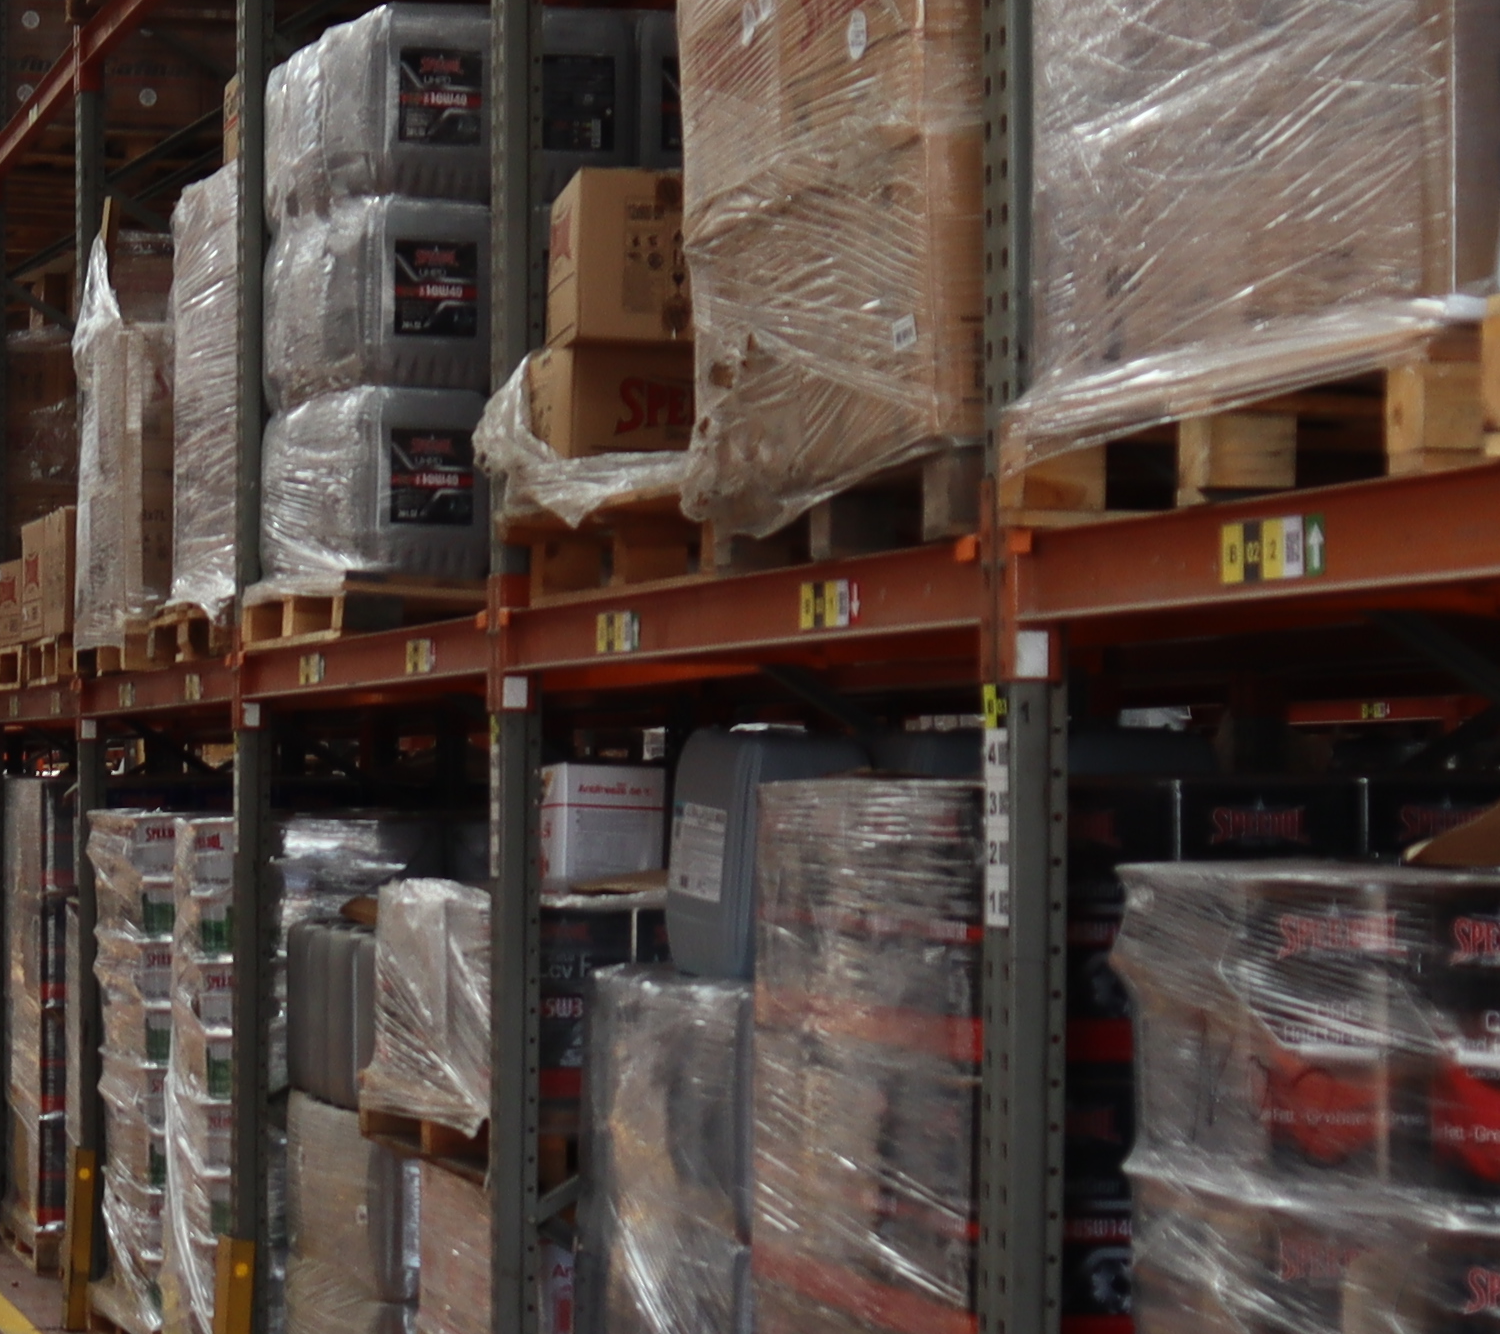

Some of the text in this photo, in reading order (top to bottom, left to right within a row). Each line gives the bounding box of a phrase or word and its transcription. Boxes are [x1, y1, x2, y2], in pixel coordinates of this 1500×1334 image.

[987, 742, 997, 765] 4
[988, 790, 997, 815] 3
[988, 840, 998, 865] 2
[988, 891, 997, 914] 1
